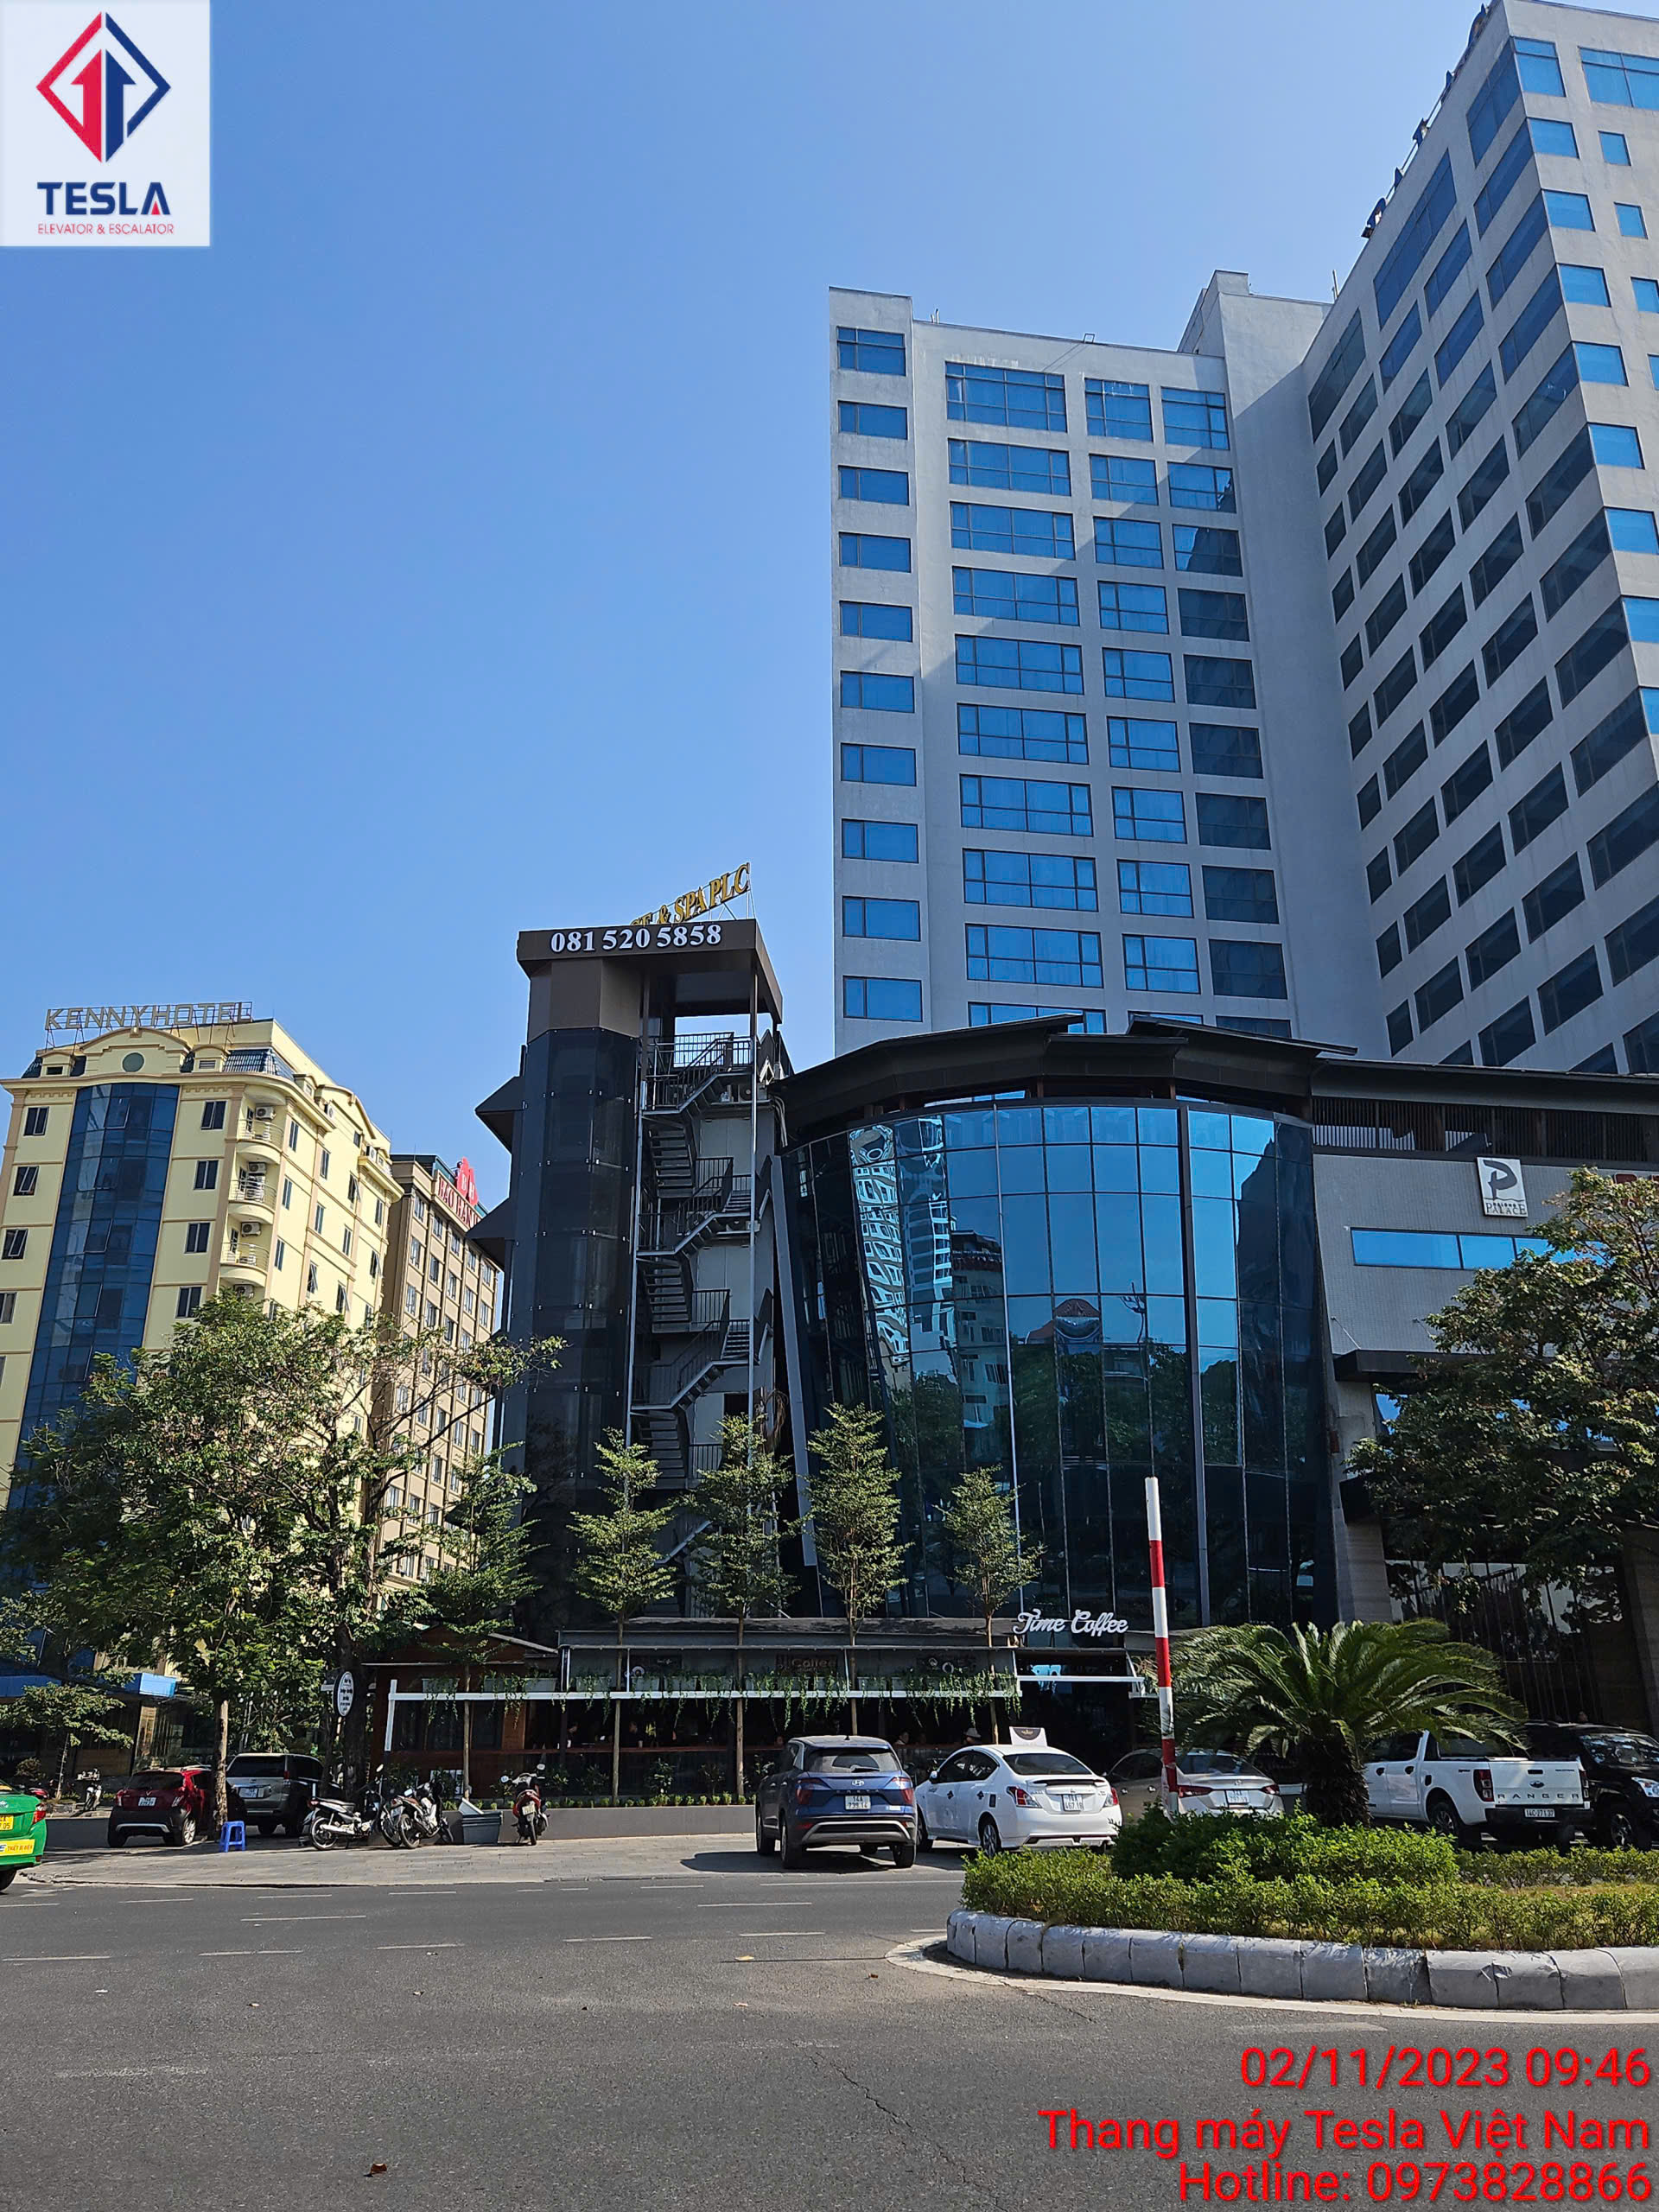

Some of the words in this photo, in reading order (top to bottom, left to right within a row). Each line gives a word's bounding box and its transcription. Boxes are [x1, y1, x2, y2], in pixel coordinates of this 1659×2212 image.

[657, 905, 672, 925] &
[674, 887, 708, 923] SPA
[709, 862, 750, 910] PLC
[550, 931, 595, 953] 081
[602, 928, 651, 950] 520
[656, 925, 722, 948] 5858
[1485, 1203, 1527, 1215] PALACE
[1013, 1609, 1065, 1635] Time
[1071, 1610, 1129, 1637] Coffee
